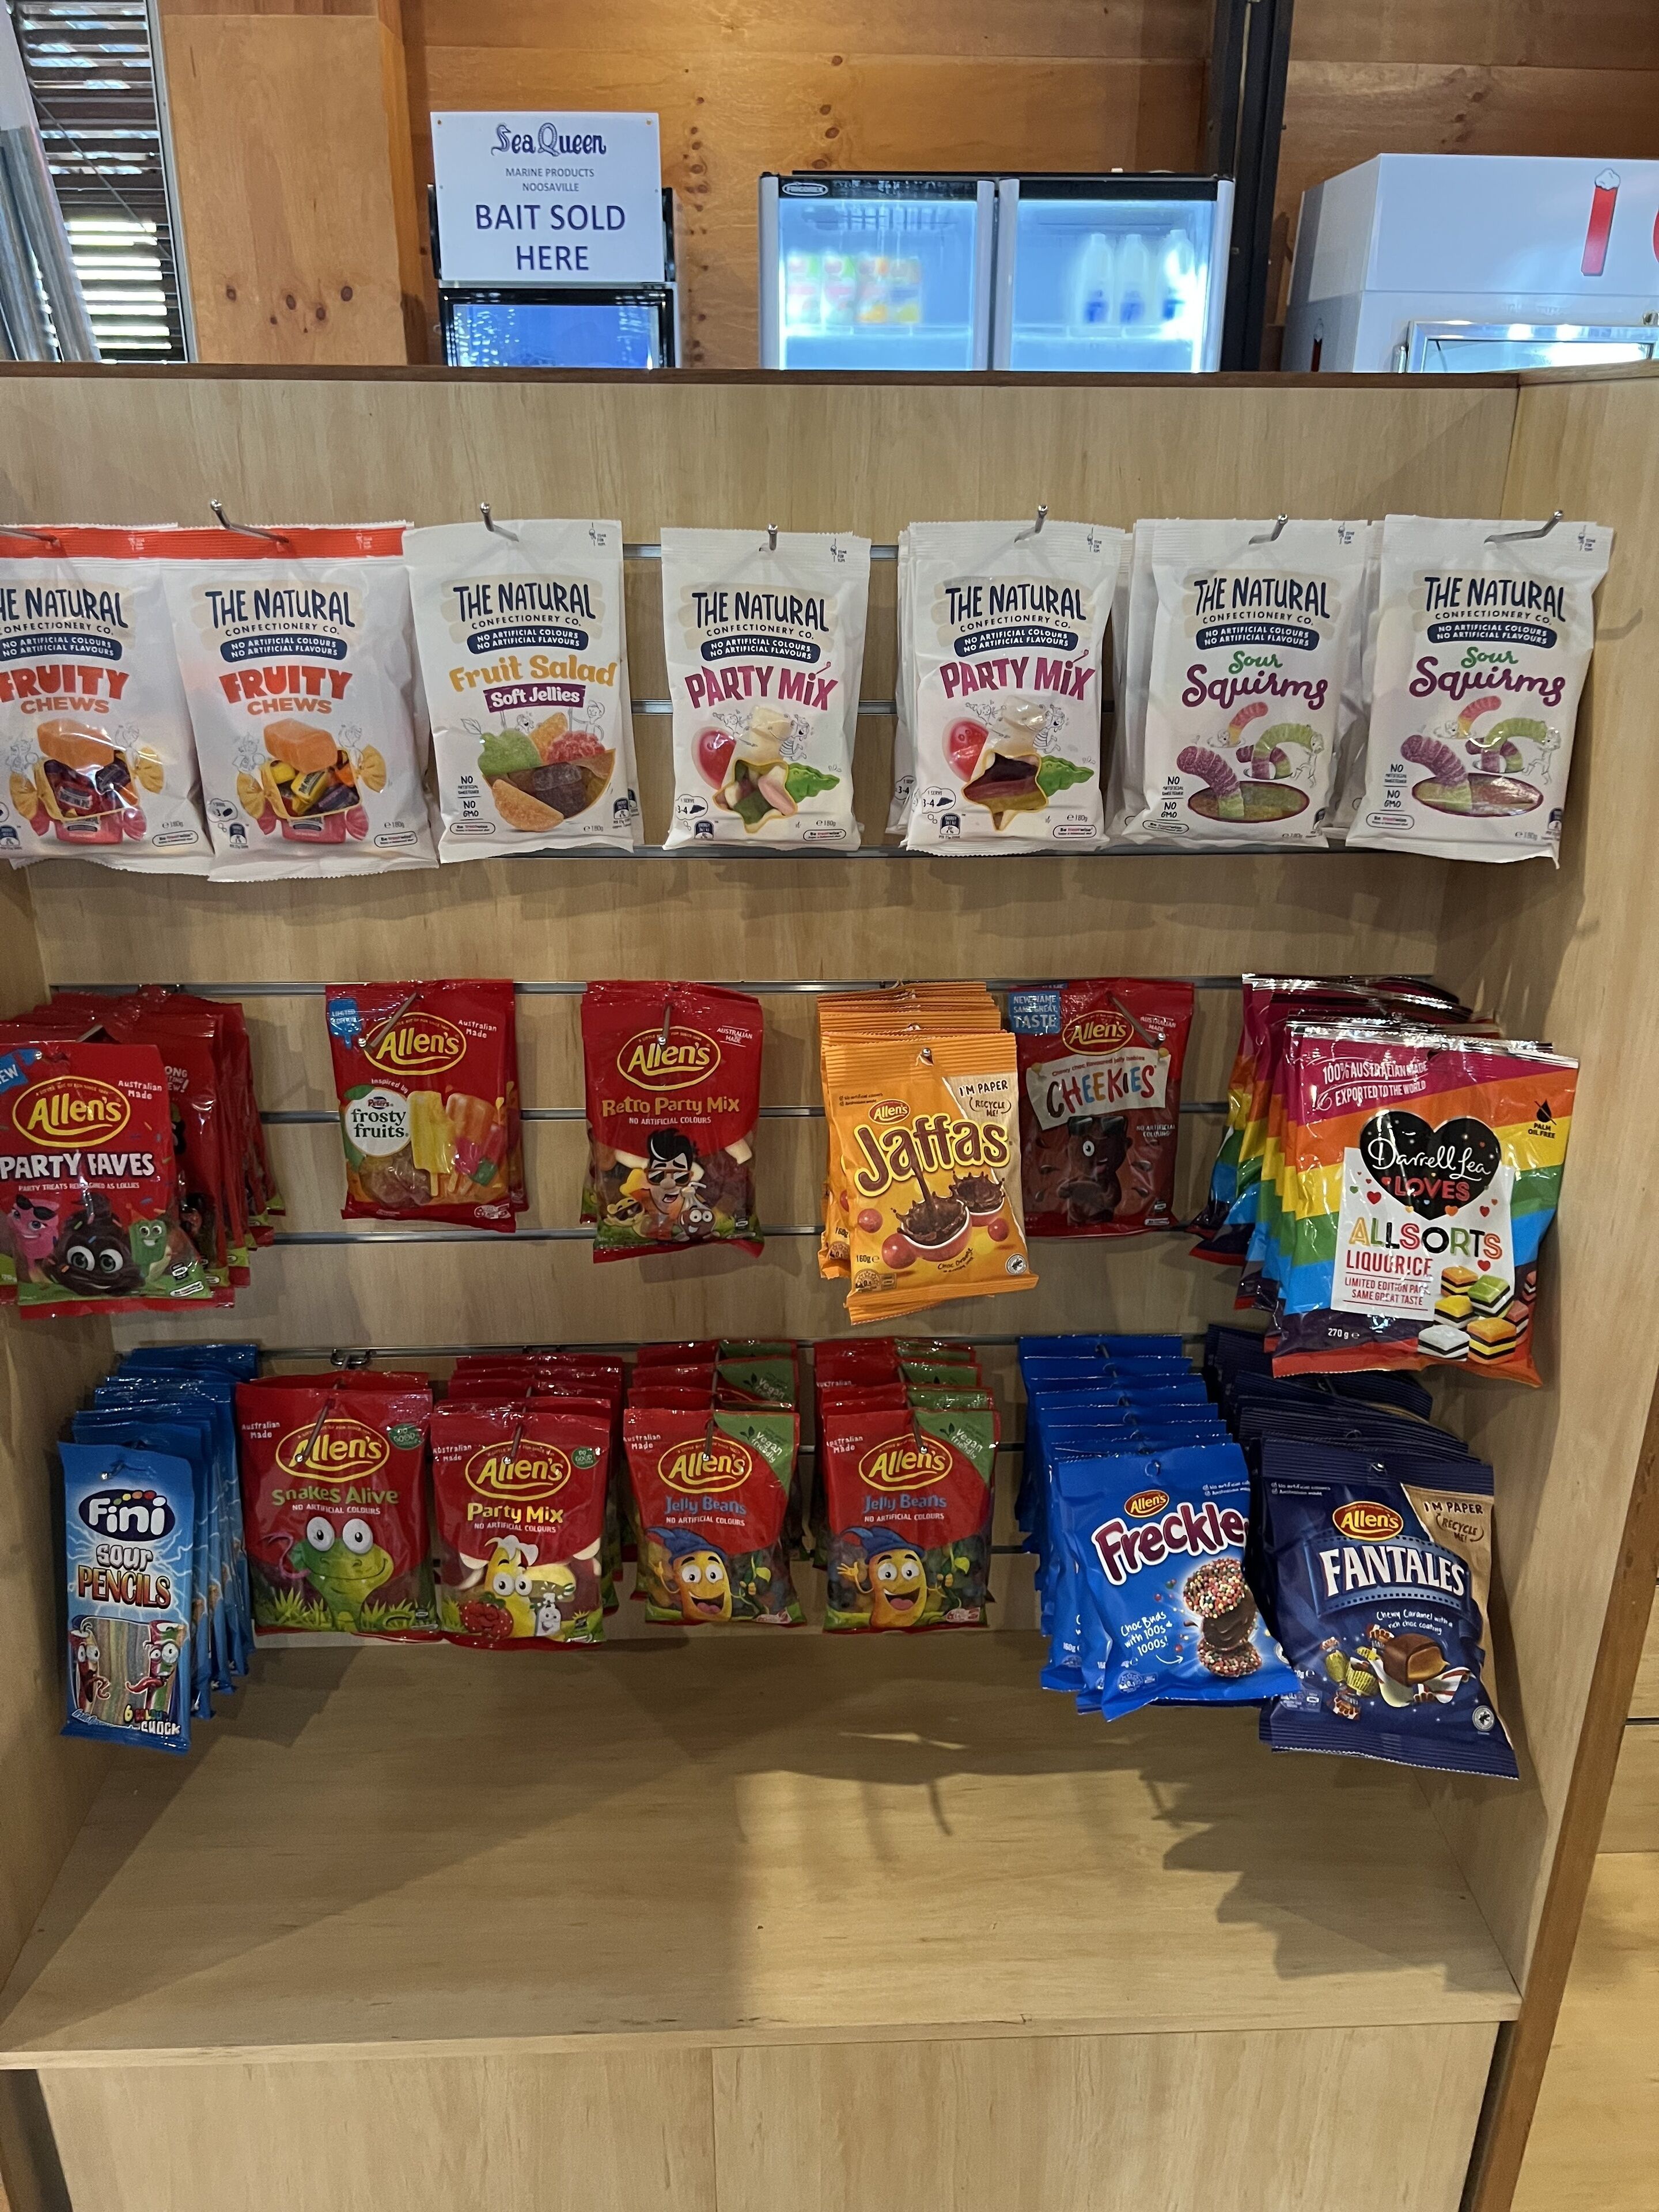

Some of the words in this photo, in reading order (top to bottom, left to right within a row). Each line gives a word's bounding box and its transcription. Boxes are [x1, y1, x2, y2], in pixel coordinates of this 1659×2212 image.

[491, 123, 536, 156] Sea
[537, 123, 607, 157] Queen
[506, 168, 543, 177] MARINE
[546, 169, 594, 177] PRODUCTS
[522, 183, 579, 191] NOOSAVILLE
[476, 204, 541, 230] BAIT
[550, 204, 625, 230] SOLD
[516, 246, 589, 270] HERE
[25, 588, 128, 628] NATURAL
[205, 589, 248, 628] THE
[254, 588, 355, 628] NATURAL
[453, 584, 493, 622] THE
[498, 582, 596, 619] NATURAL
[945, 586, 983, 625] THE
[989, 584, 1086, 620] NATURAL
[1194, 577, 1227, 616] THE
[1232, 577, 1330, 619] NATURAL
[1424, 577, 1463, 612] THE
[1467, 577, 1566, 622] NATURAL
[691, 592, 729, 628] THE
[735, 591, 830, 632] NATURAL
[1203, 611, 1293, 624] CONFECTIONERY
[1435, 611, 1531, 620] CONFECTIONERY
[225, 623, 317, 636] CONFECTIONERY
[472, 615, 560, 630] CONFECTIONERY
[565, 618, 581, 627] CO.
[706, 624, 794, 637] CONFECTIONERY
[799, 631, 814, 639] CO.
[960, 615, 1050, 632] CONFECTIONERY
[1055, 620, 1071, 628] CO.
[476, 642, 490, 650] NO
[493, 637, 536, 647] ARTIFICIAL
[538, 637, 579, 647] FLAVOURS
[477, 634, 490, 642] NO
[493, 629, 537, 639] ARTIFICIAL
[539, 630, 578, 639] COLOURS
[711, 641, 724, 650] NO
[726, 638, 770, 647] ARTIFICIAL
[772, 640, 811, 652] COLOURS
[710, 649, 723, 657] NO
[725, 646, 768, 654] ARTIFICIAL
[771, 647, 812, 660] FLAVOURS
[1228, 650, 1283, 675] Sour
[1461, 646, 1518, 669] Sour
[449, 655, 523, 692] Fruit
[529, 654, 618, 687] Salad
[940, 657, 1029, 699] PARTY
[1409, 656, 1566, 707] Squirms
[0, 664, 130, 703] FRUITY
[218, 665, 353, 704] FRUITY
[684, 665, 774, 709] PARTY
[1181, 664, 1328, 710] Squirms
[21, 696, 109, 714] CHEWS
[247, 698, 332, 715] CHEWS
[490, 689, 527, 707] Soft
[529, 686, 580, 703] Jellies
[461, 775, 474, 784] NO
[1168, 776, 1180, 785] NO
[463, 801, 476, 809] NO
[1164, 802, 1177, 810] NO
[458, 1020, 497, 1032] Australian
[1014, 1014, 1056, 1028] TASTE
[466, 1029, 487, 1038] Made
[717, 1027, 753, 1039] AUSTRALIAN
[725, 1035, 741, 1044] MADE
[1069, 1021, 1127, 1045] Allen's
[376, 1027, 460, 1065] Allen's
[627, 1042, 710, 1076] Allen's
[371, 1078, 400, 1088] Inspired
[1323, 1063, 1349, 1084] 100%
[118, 1080, 162, 1092] Australian
[128, 1090, 152, 1100] Made
[959, 1085, 975, 1097] I'M
[978, 1080, 1008, 1094] PAPER
[1047, 1065, 1154, 1118] CHEEKIES
[1335, 1085, 1378, 1106] EXPORTED
[1390, 1085, 1403, 1096] THE
[1403, 1080, 1426, 1094] WORLD
[27, 1093, 122, 1136] Allen's
[602, 1096, 650, 1117] Retro
[655, 1097, 703, 1115] Party
[707, 1096, 740, 1113] Mix
[874, 1103, 908, 1121] Allen's
[976, 1101, 1005, 1109] RECYCLE
[351, 1108, 406, 1126] frosty
[354, 1123, 404, 1138] fruits
[1533, 1123, 1551, 1132] PALM
[1539, 1130, 1556, 1139] FREE
[856, 1114, 1008, 1193] Jaffas
[1368, 1138, 1456, 1170] Darrell
[1449, 1148, 1491, 1180] Lea
[0, 1153, 81, 1180] PARTY
[87, 1153, 155, 1176] FAVES
[1394, 1176, 1471, 1201] LOVES
[1348, 1217, 1503, 1260] ALLSORTS
[1346, 1250, 1433, 1277] LIQUORICE
[1345, 1277, 1376, 1289] LIMITED
[1378, 1281, 1408, 1292] EDITION
[1351, 1289, 1374, 1300] SAME
[1402, 1295, 1423, 1305] TASTE
[241, 1422, 280, 1430] Australian
[250, 1431, 272, 1439] Made
[289, 1434, 382, 1471] Allen's
[476, 1457, 563, 1490] Allen's
[668, 1453, 745, 1485] Allen's
[869, 1449, 946, 1482] Allen's
[271, 1486, 342, 1506] Snakes
[346, 1486, 399, 1505] Alive
[664, 1495, 698, 1514] Jelly
[702, 1496, 747, 1514] Beans
[863, 1494, 896, 1513] Jelly
[900, 1494, 947, 1509] Beans
[1130, 1493, 1166, 1515] Allen's
[89, 1497, 166, 1535] Fini
[306, 1504, 344, 1514] ARTIFICIAL
[347, 1506, 380, 1514] COLOURS
[467, 1502, 521, 1524] Party
[527, 1506, 564, 1524] Mix
[1424, 1501, 1442, 1513] I'M
[1446, 1502, 1483, 1514] PAPER
[1343, 1509, 1399, 1535] Allen's
[1441, 1518, 1478, 1536] RECYCLE
[96, 1544, 153, 1571] sour
[1319, 1544, 1465, 1598] FANTALES
[78, 1565, 171, 1609] PENCILS
[1376, 1611, 1401, 1620] Chewy
[1403, 1609, 1433, 1620] Caramel
[1120, 1621, 1142, 1637] Choc
[1124, 1633, 1143, 1648] with
[1144, 1625, 1166, 1639] 100s
[1137, 1636, 1168, 1656] 1000s!
